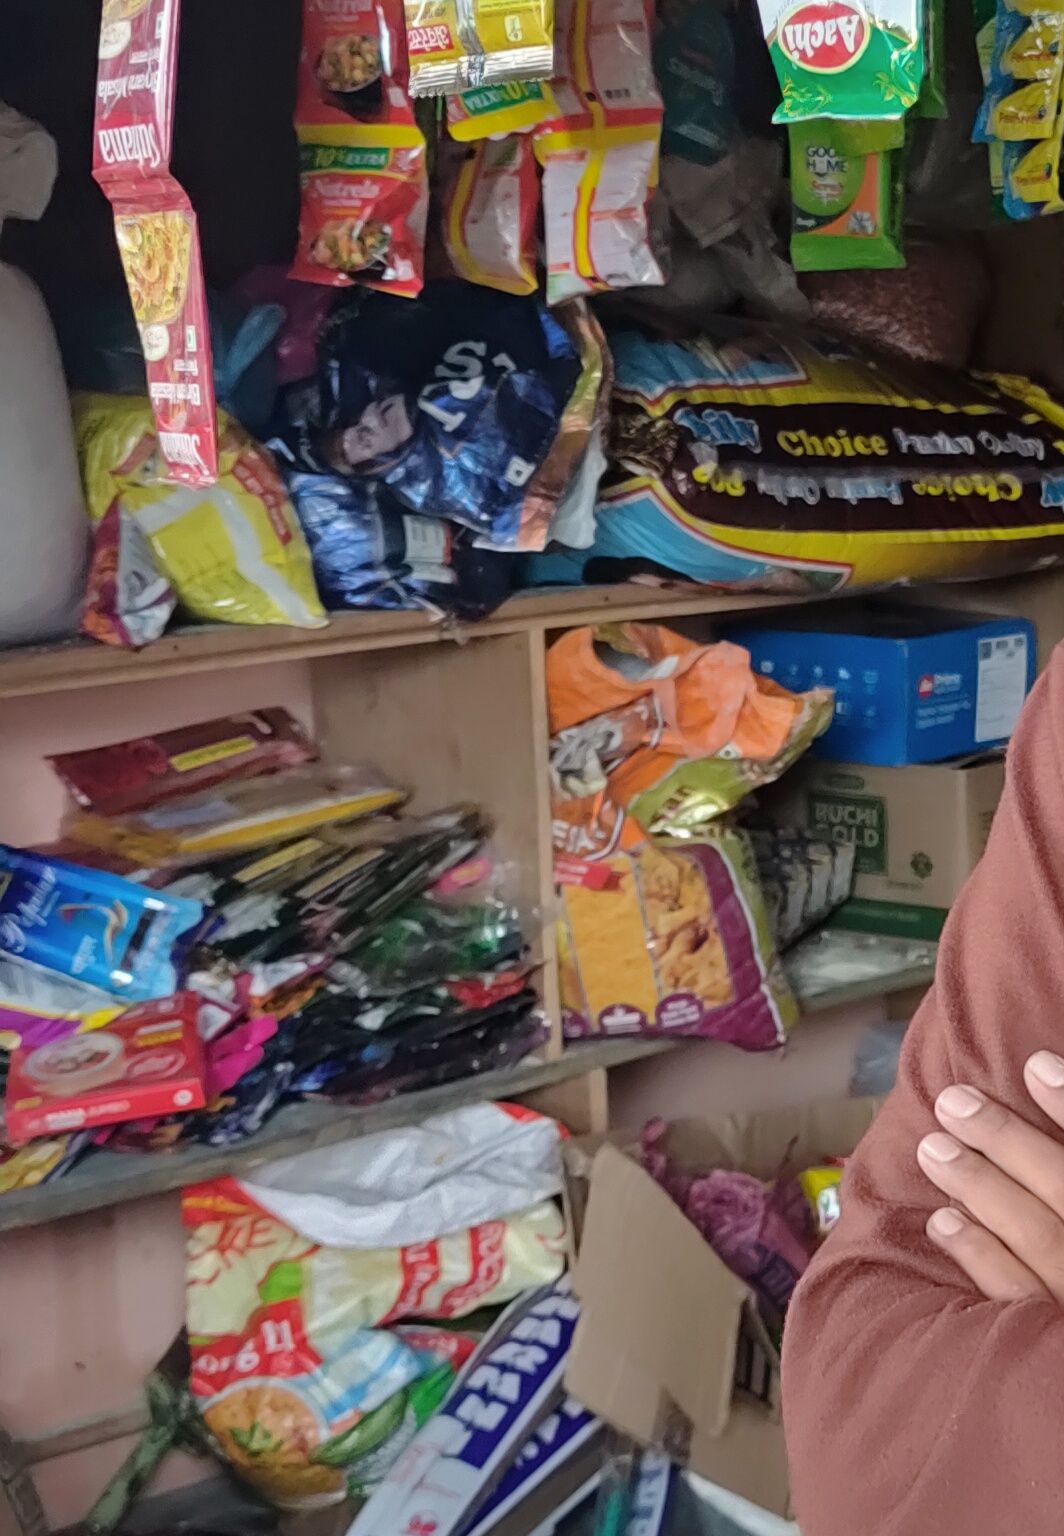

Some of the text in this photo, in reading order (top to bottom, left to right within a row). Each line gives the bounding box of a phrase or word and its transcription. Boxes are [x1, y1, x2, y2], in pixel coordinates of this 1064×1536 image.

[785, 14, 860, 65] Aachi
[99, 122, 160, 167] Suhana
[776, 427, 889, 458] Choice
[820, 825, 880, 849] OLD
